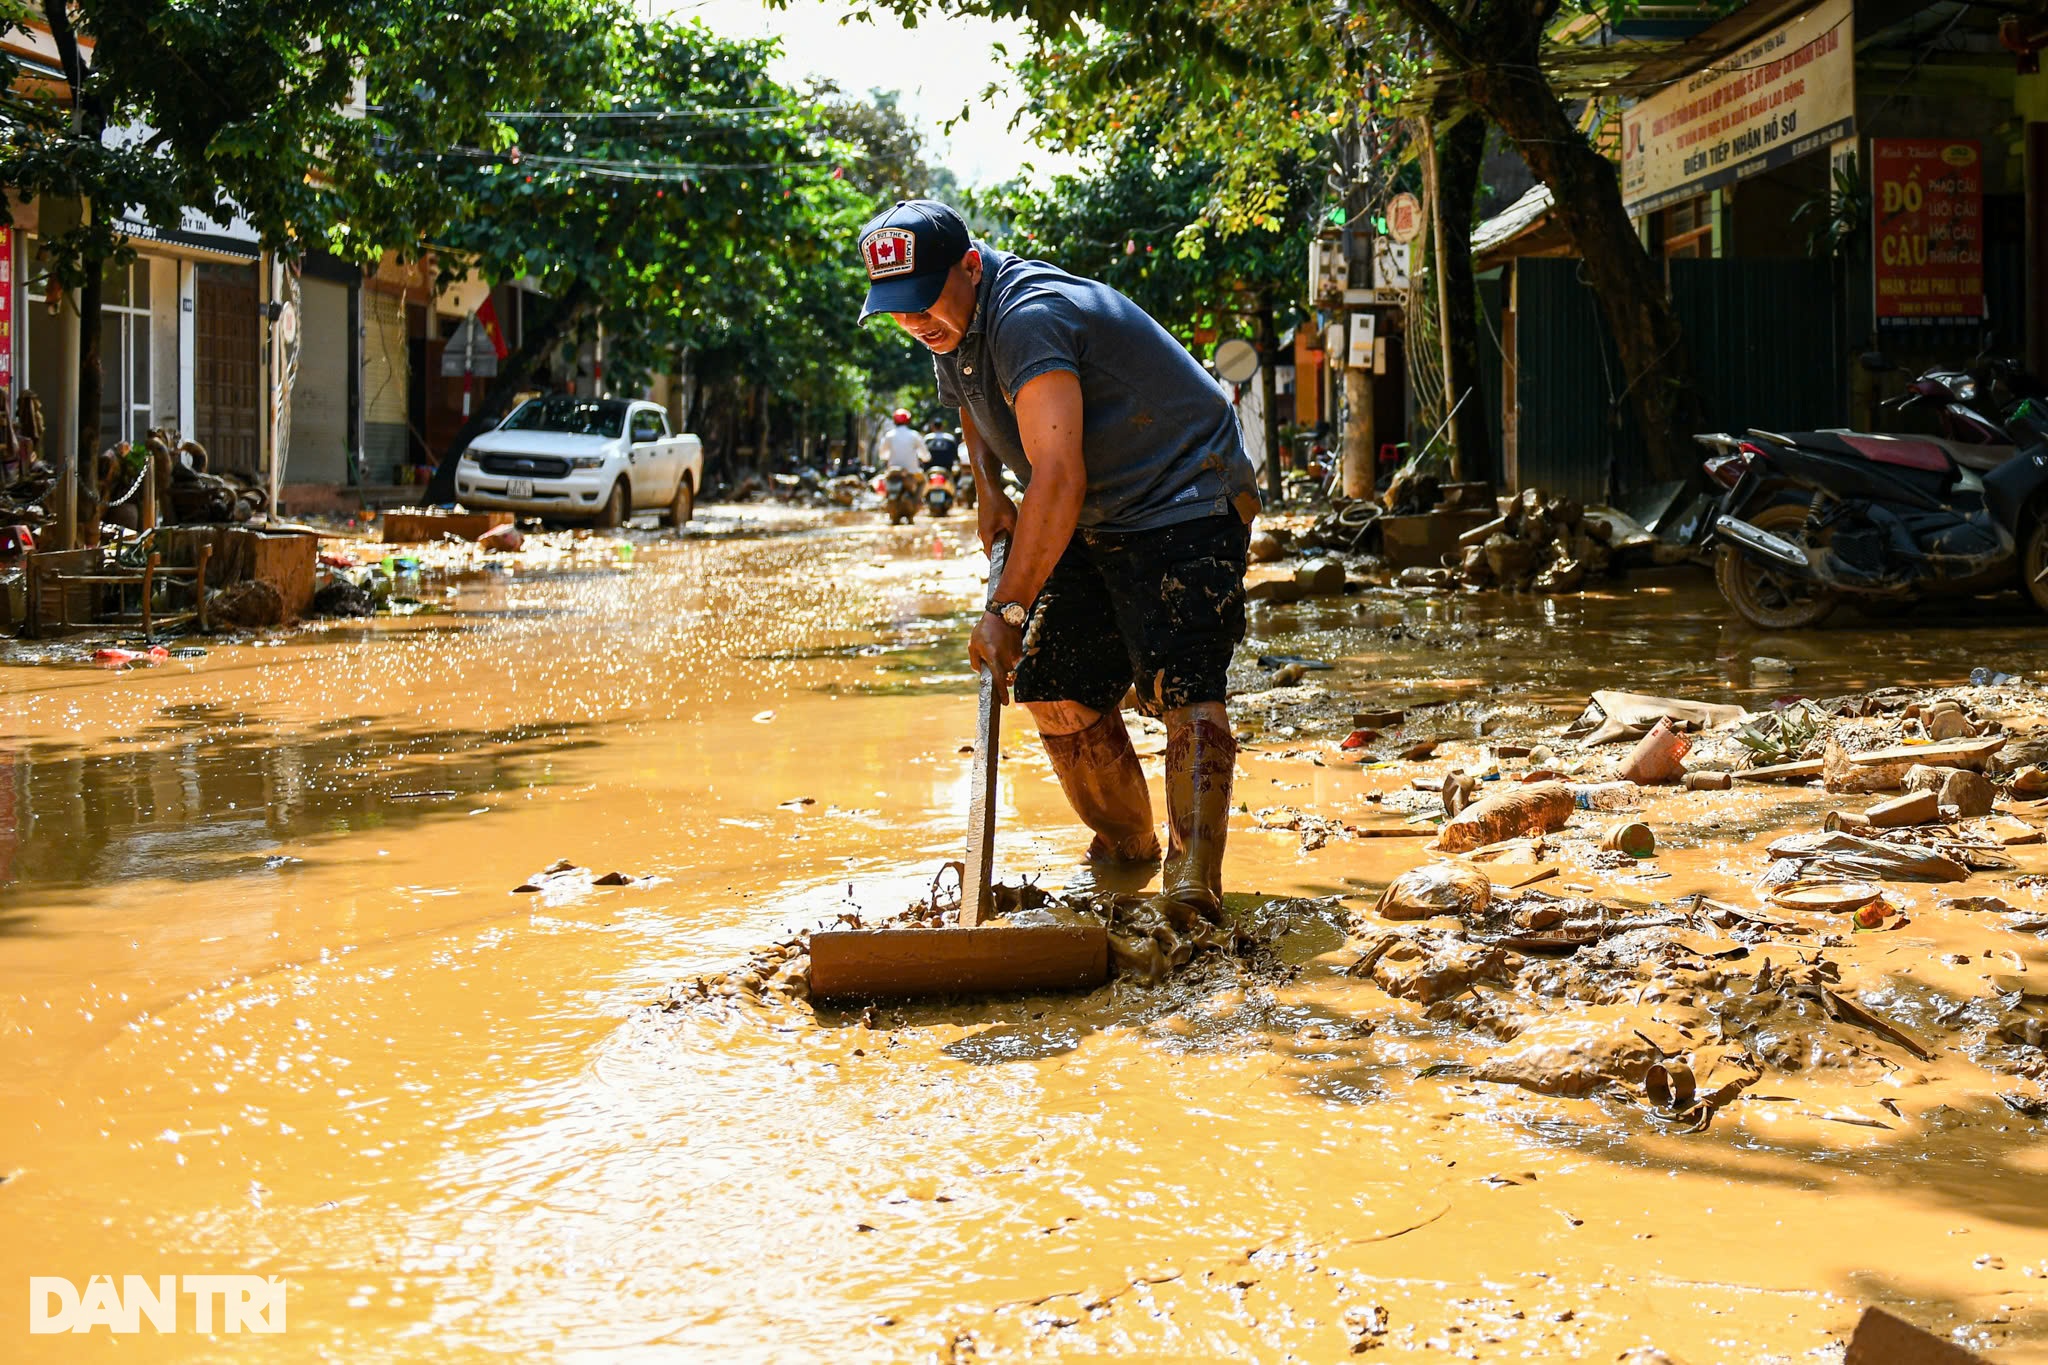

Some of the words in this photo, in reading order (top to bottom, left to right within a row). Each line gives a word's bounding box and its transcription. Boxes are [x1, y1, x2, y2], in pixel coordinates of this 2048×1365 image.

[1709, 137, 1730, 167] TIẾP
[1733, 128, 1761, 156] NHẬN
[1764, 113, 1778, 145] HỒ
[1782, 110, 1797, 137] SƠ
[1882, 164, 1923, 213] ĐỒ
[1881, 224, 1928, 266] CÂU
